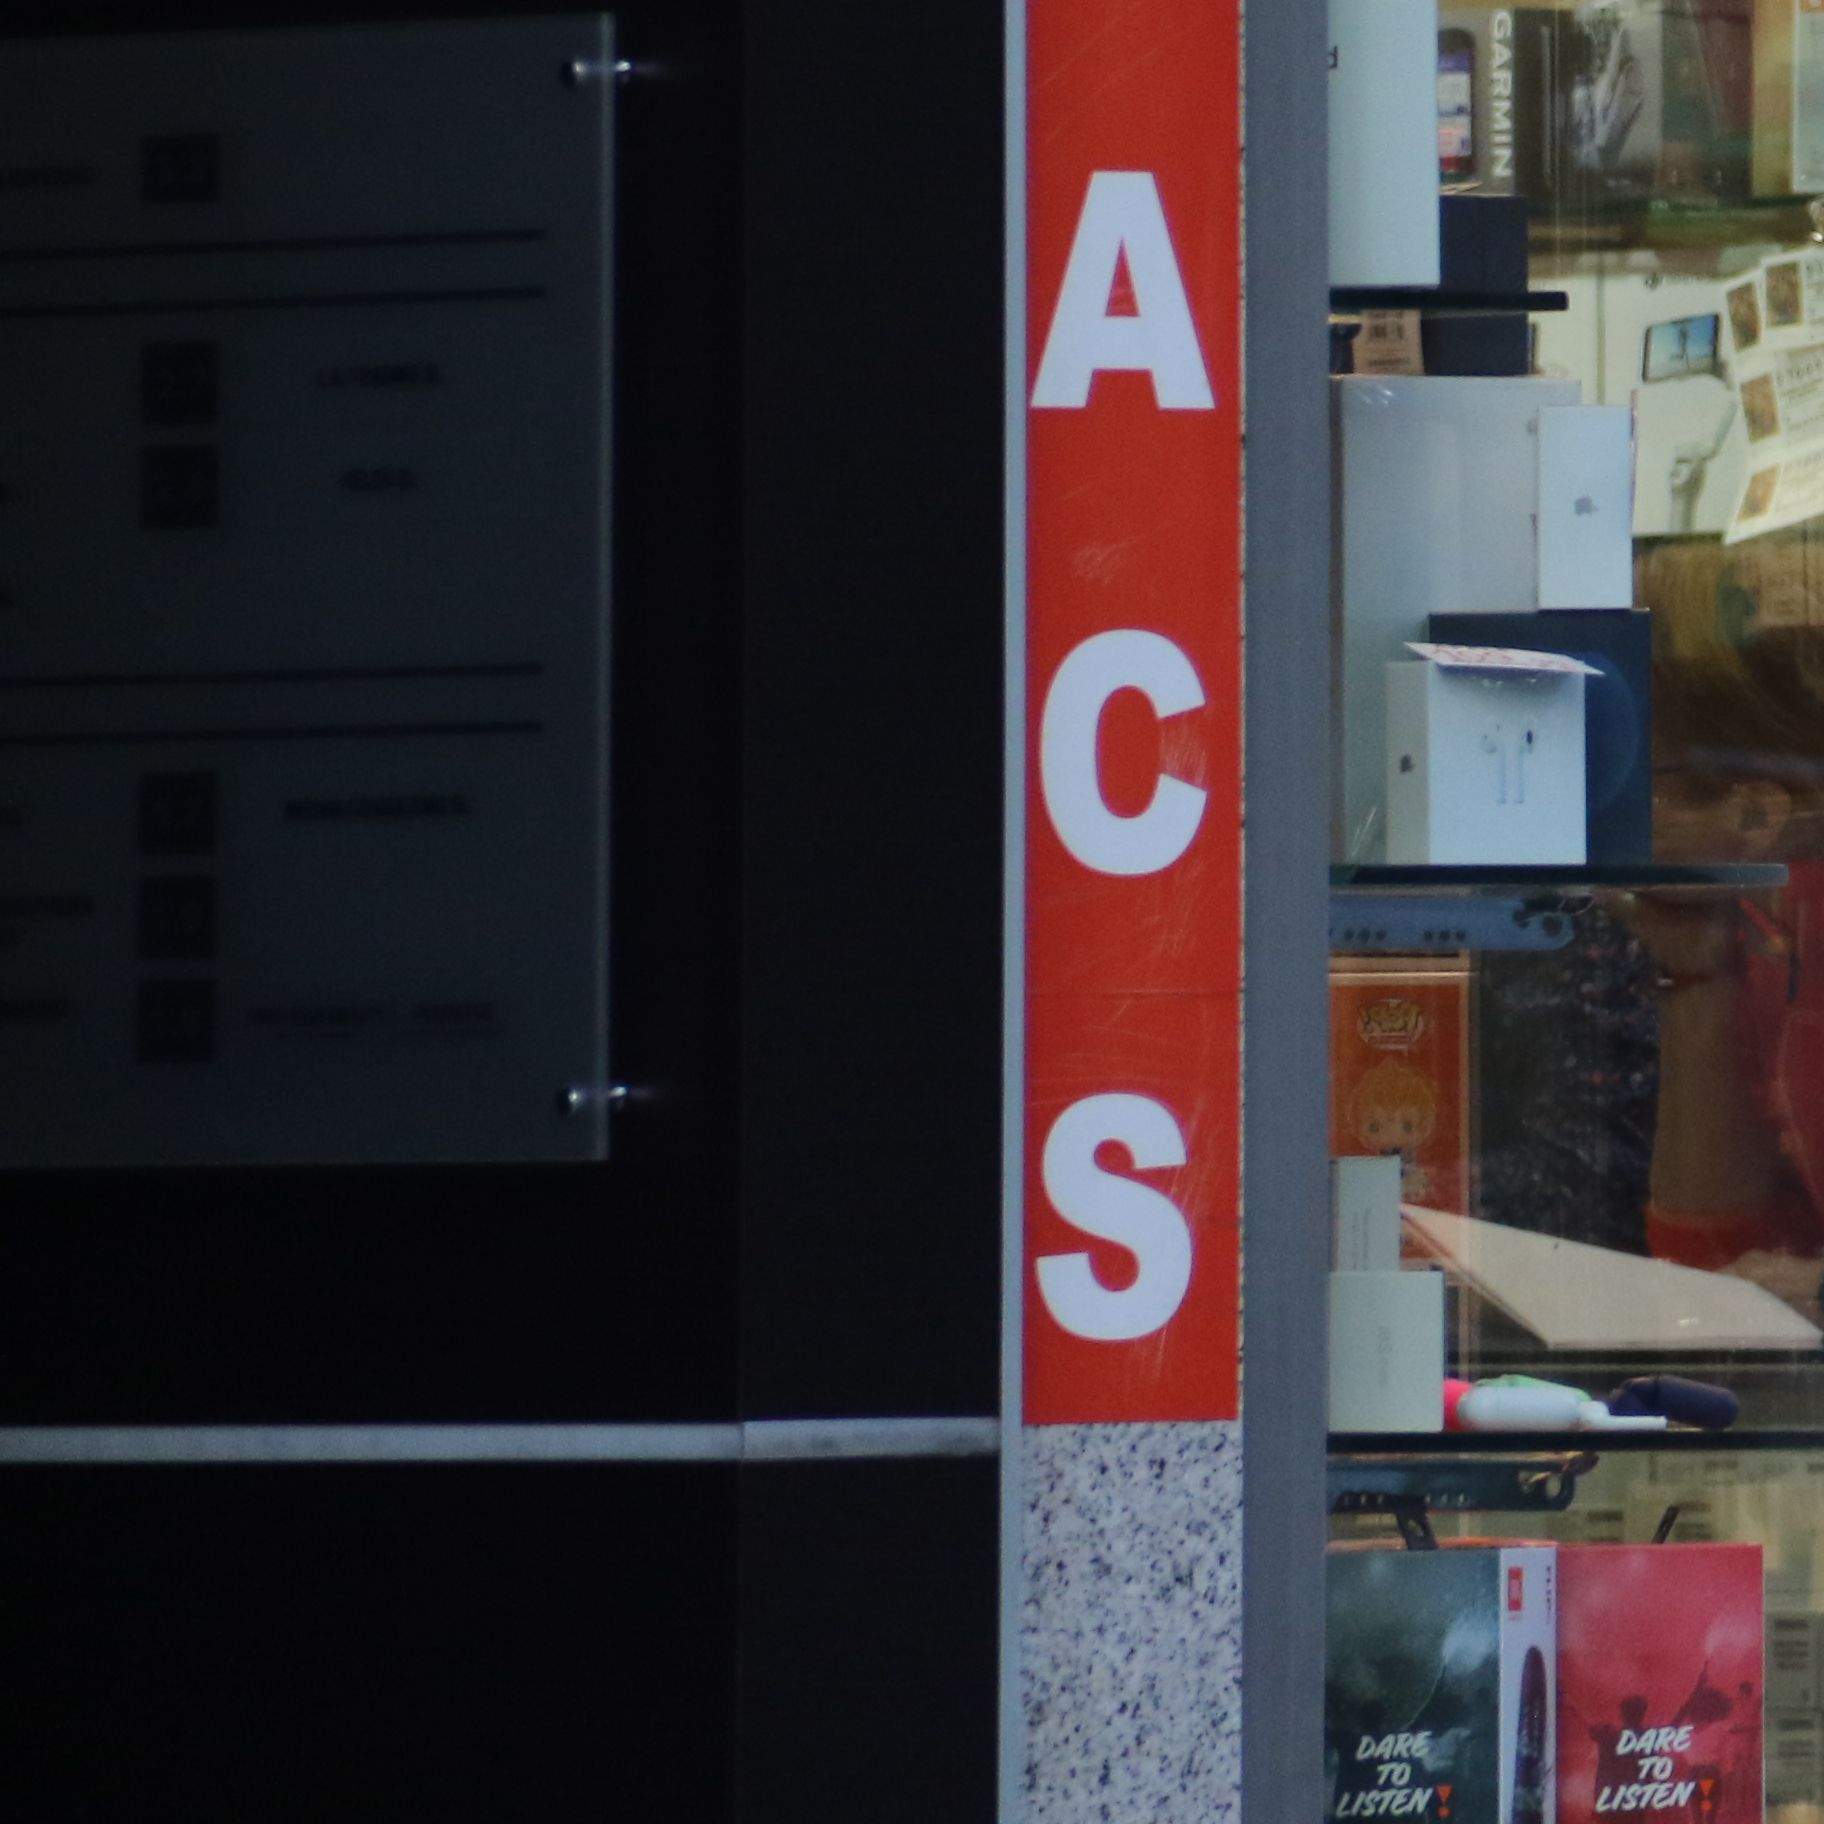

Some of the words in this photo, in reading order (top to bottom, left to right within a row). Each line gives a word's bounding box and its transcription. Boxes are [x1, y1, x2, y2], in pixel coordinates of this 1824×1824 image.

[1490, 10, 1514, 177] GARMIN
[1355, 1728, 1434, 1761] DARE
[1615, 1723, 1695, 1756] DARE
[1377, 1763, 1411, 1789] TO
[1637, 1756, 1675, 1782] TO
